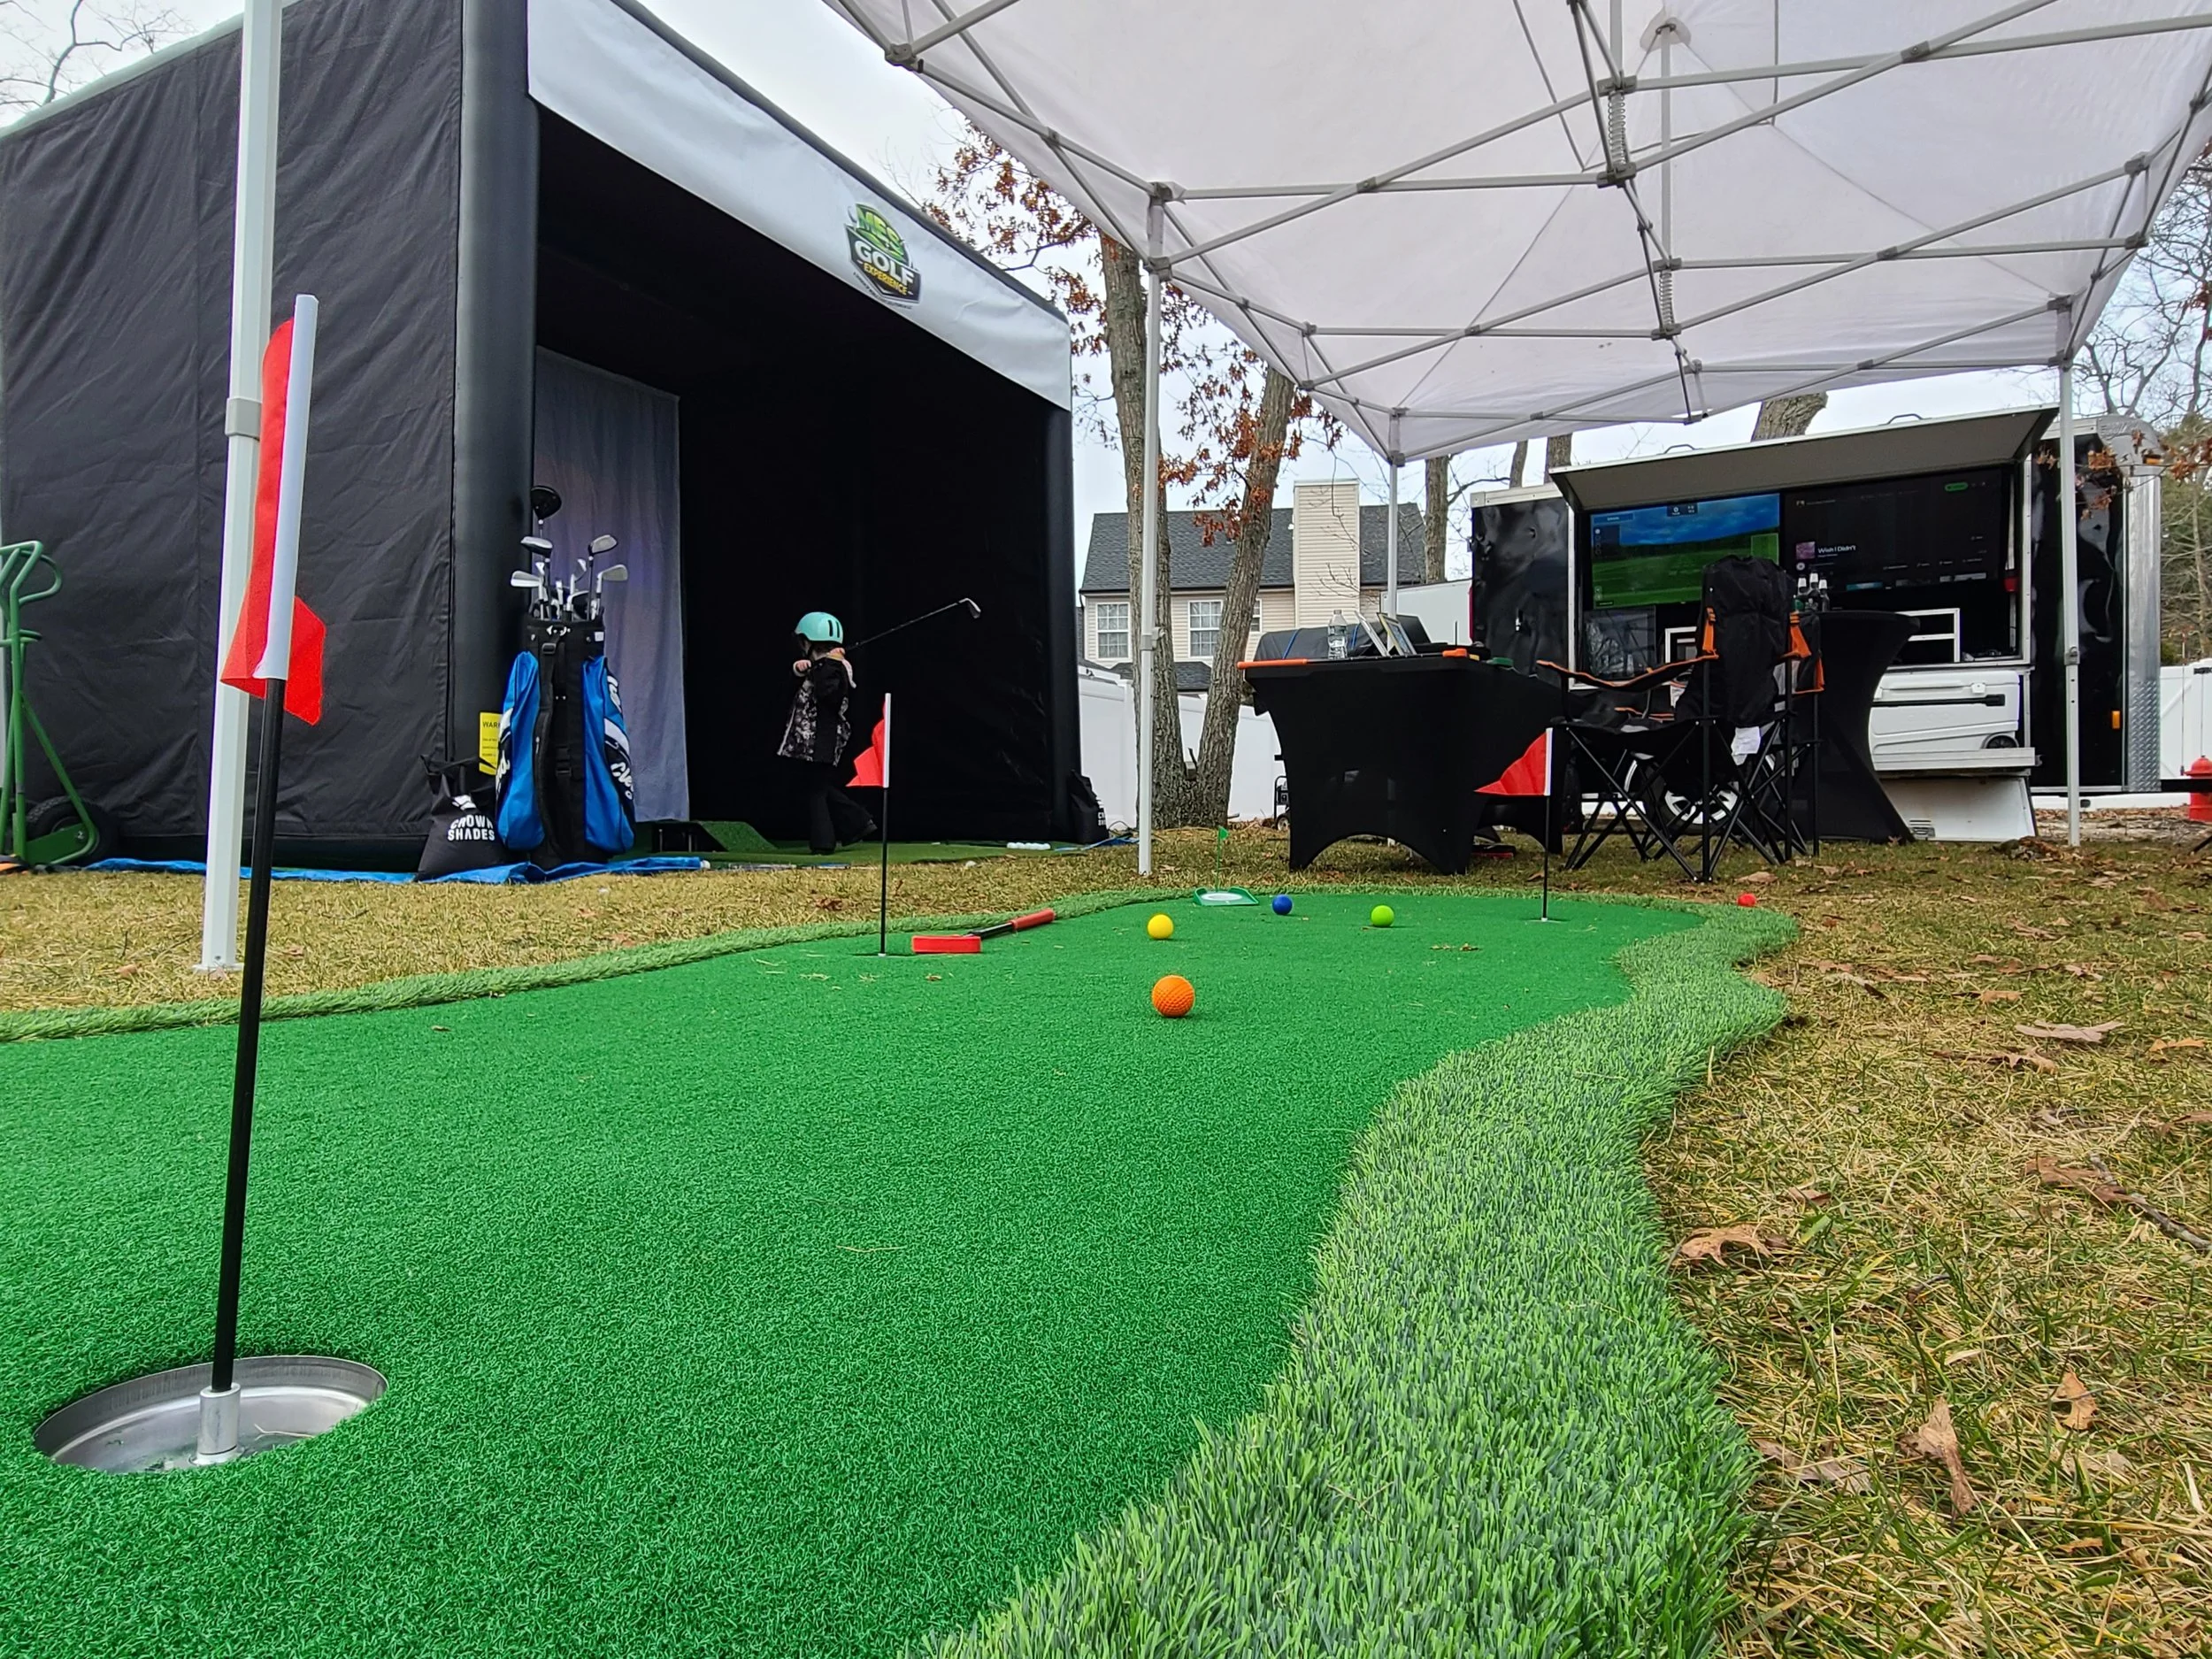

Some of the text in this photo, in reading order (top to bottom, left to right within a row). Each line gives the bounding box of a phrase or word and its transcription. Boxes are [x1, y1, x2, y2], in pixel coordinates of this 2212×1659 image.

[855, 240, 915, 286] GOLF
[864, 263, 907, 296] EXPERIENCE
[448, 827, 495, 841] SHADES
[450, 814, 494, 830] CROWN
